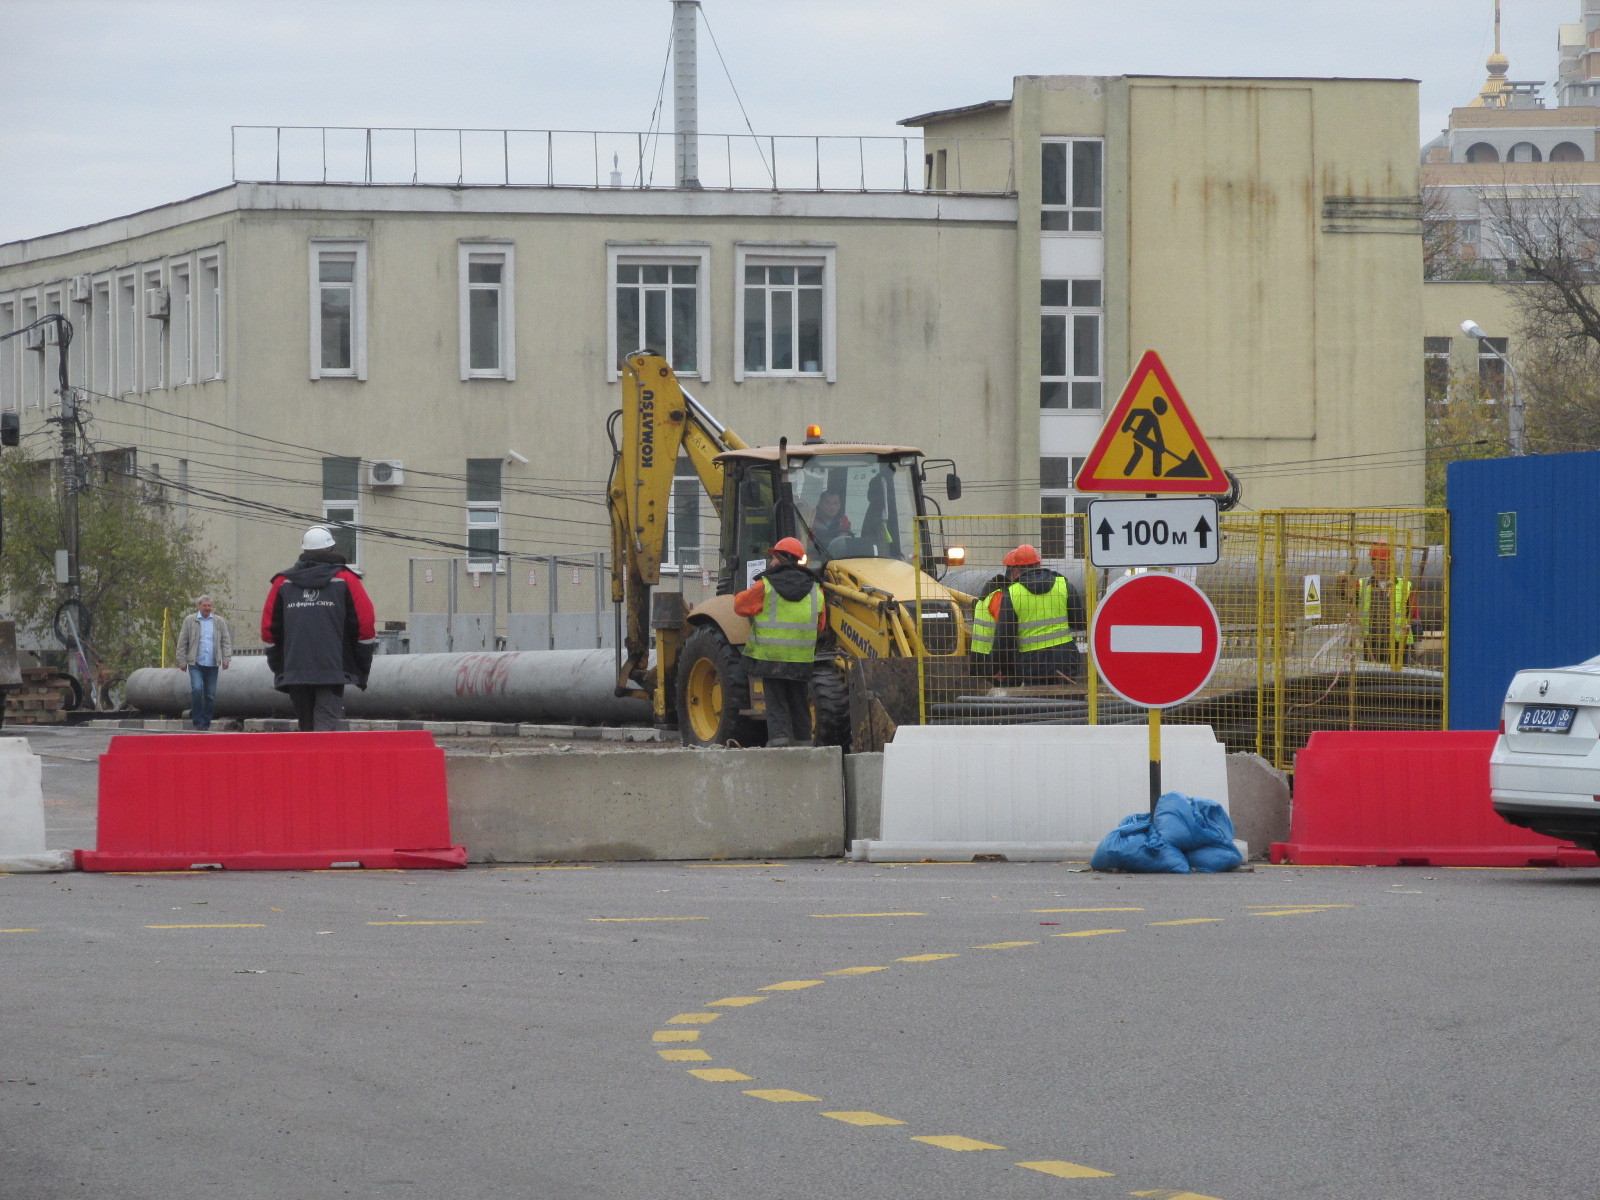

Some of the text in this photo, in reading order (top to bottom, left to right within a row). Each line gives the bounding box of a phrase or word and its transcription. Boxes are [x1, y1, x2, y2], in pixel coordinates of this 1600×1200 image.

[641, 389, 654, 468] KOMATSU
[1532, 708, 1557, 725] 0320
[1559, 709, 1570, 721] 36
